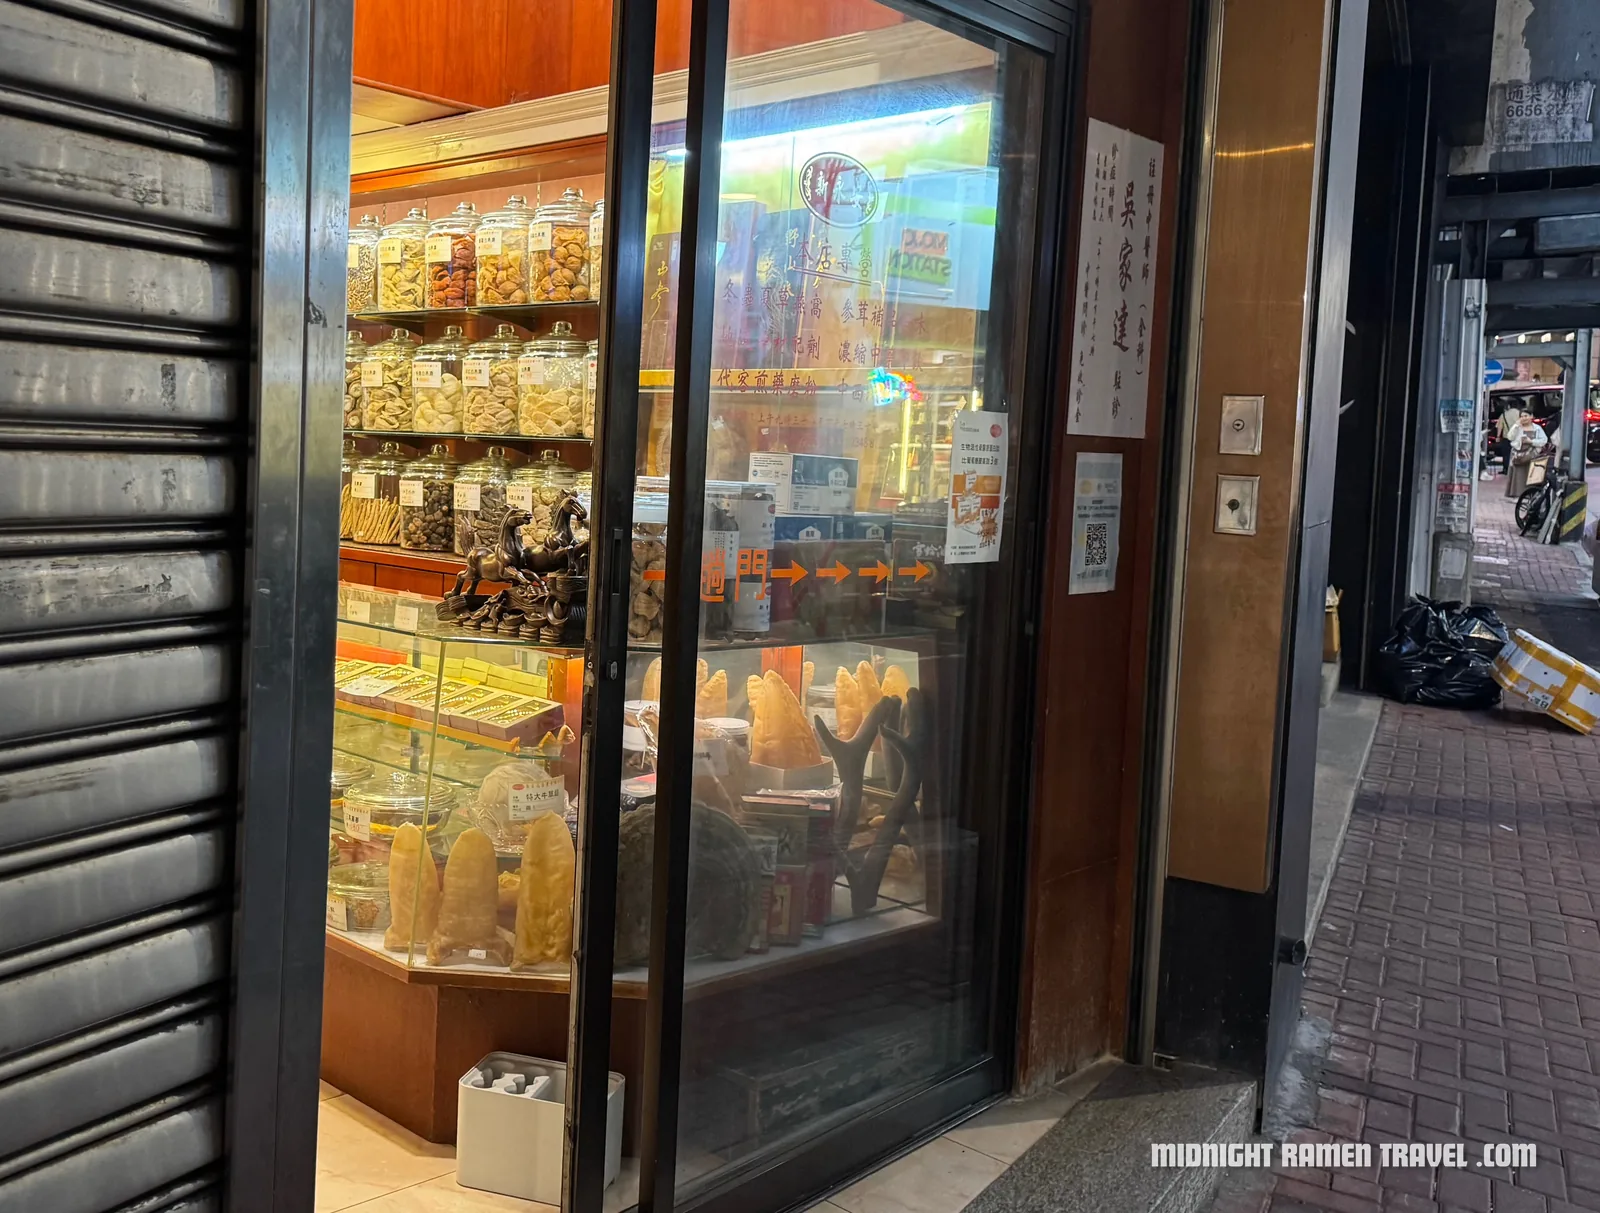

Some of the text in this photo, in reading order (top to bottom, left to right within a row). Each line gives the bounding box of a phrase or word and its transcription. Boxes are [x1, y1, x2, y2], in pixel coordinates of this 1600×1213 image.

[1506, 104, 1543, 118] 6656
[796, 231, 873, 278] 本店專營
[1112, 180, 1136, 352] 吳家達
[840, 298, 929, 335] 參茸補品味
